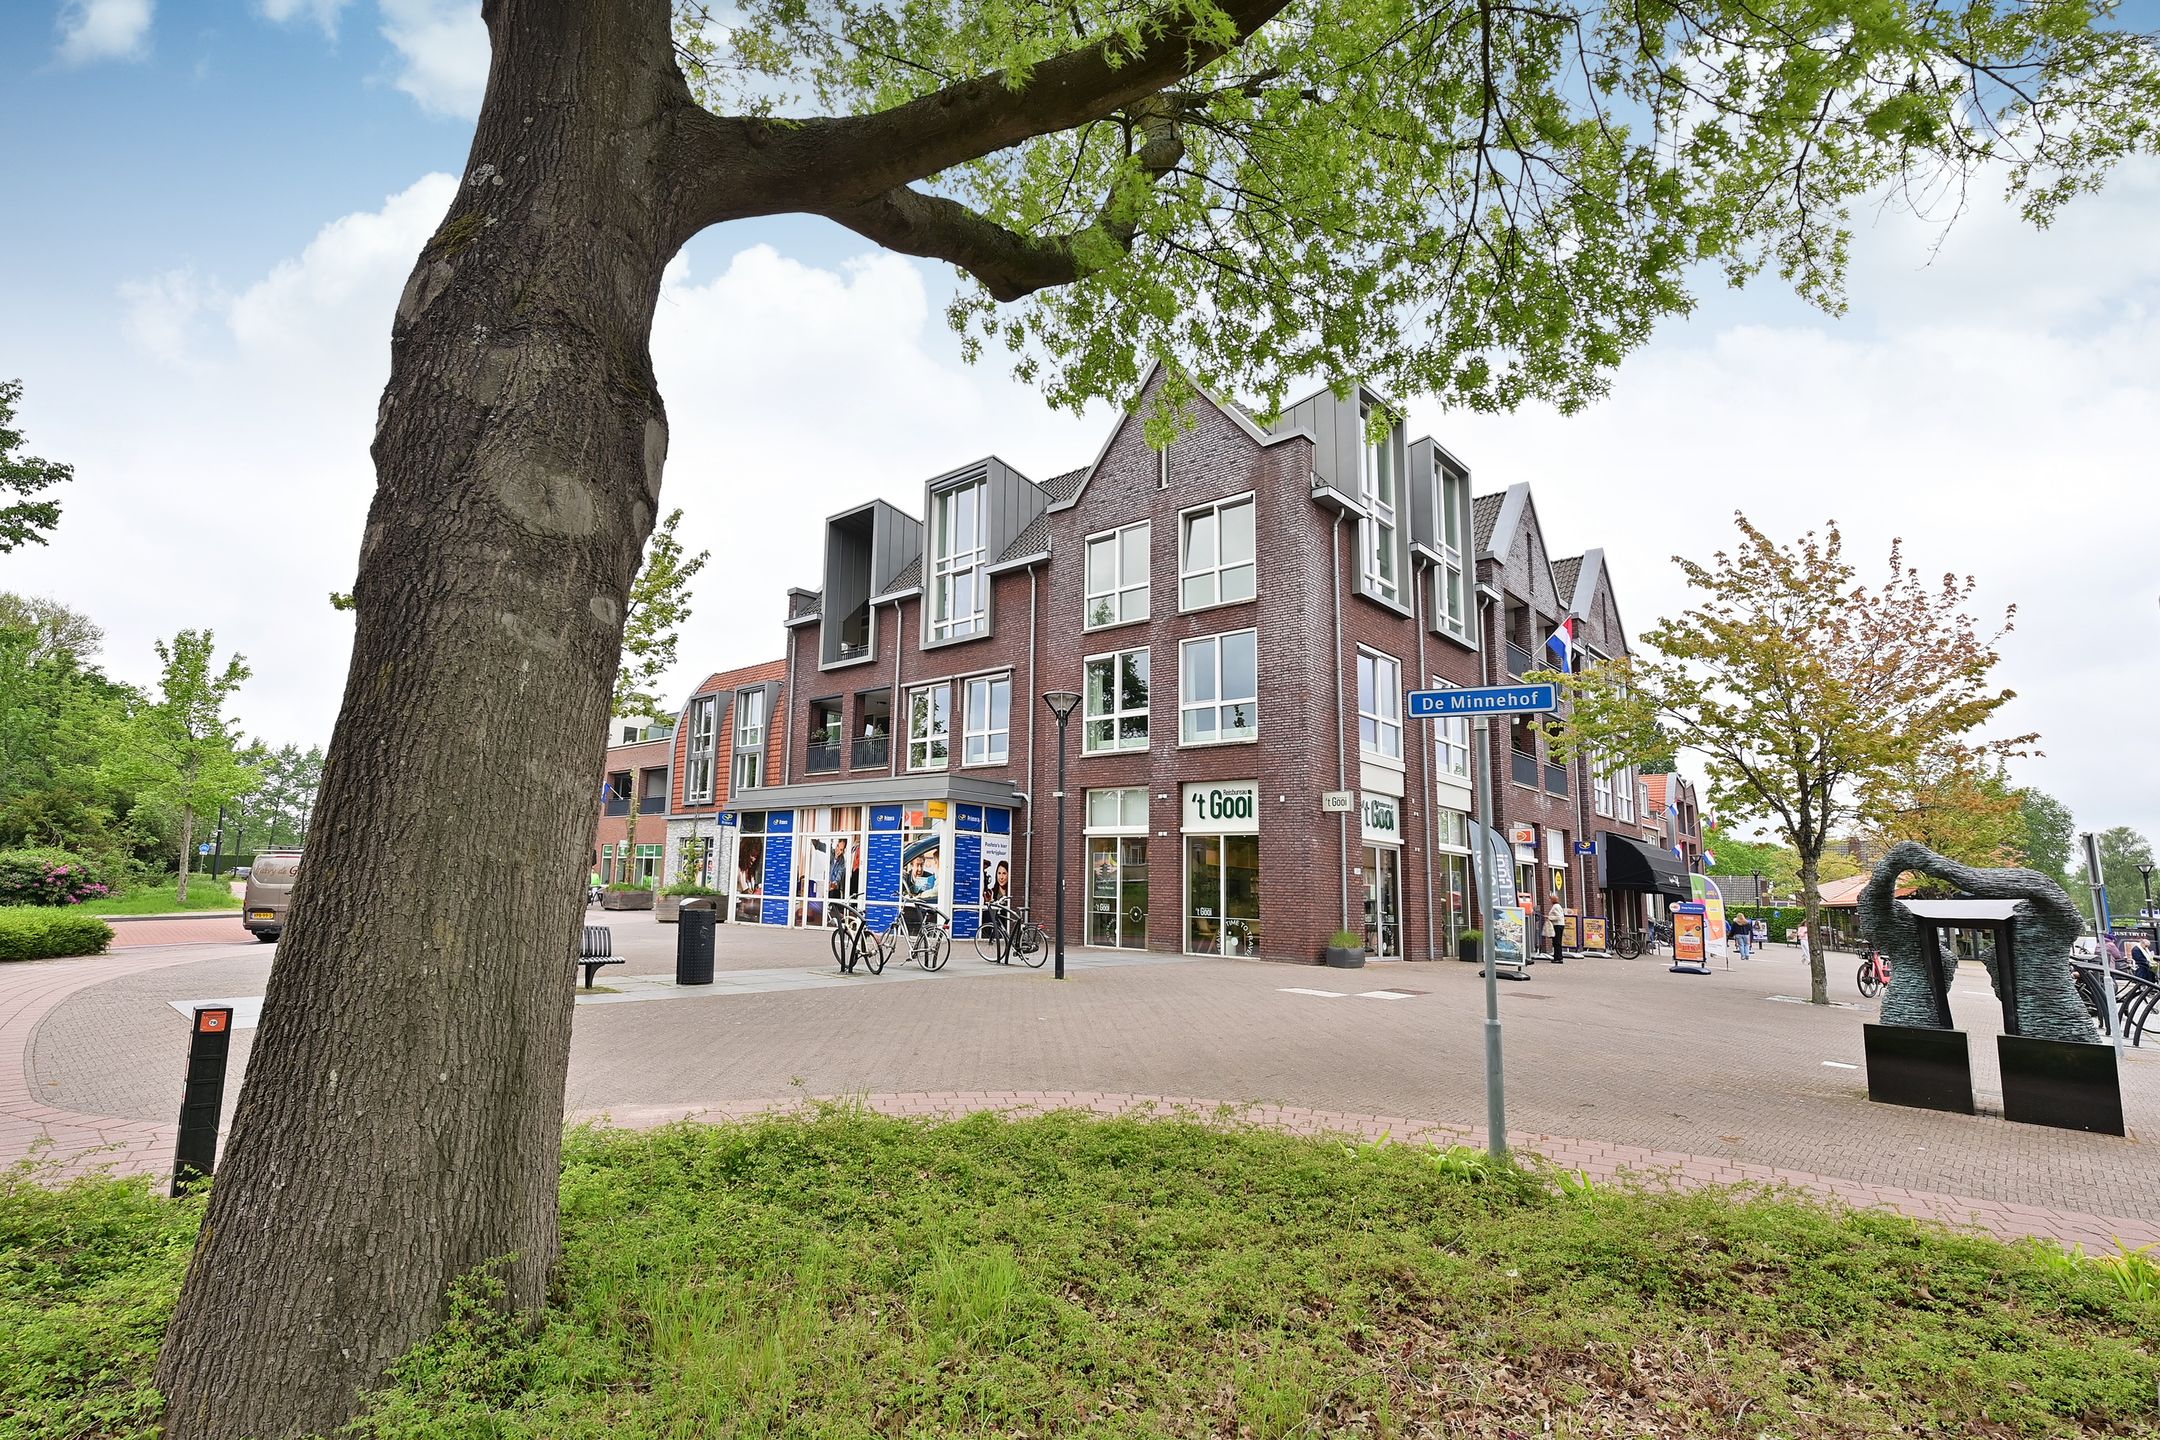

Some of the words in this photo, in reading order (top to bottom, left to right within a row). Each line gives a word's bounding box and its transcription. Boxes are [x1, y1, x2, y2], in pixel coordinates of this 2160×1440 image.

[1422, 697, 1444, 711] De
[1451, 691, 1539, 709] Minnehof
[1192, 793, 1206, 820] 't
[1210, 789, 1253, 820] Gooi
[1332, 796, 1348, 807] Gooi
[1371, 799, 1395, 831] Gooi
[1200, 906, 1213, 917] Gooi
[1225, 919, 1240, 927] TIME
[1240, 921, 1249, 932] TO
[1244, 930, 1254, 957] TRAVEL
